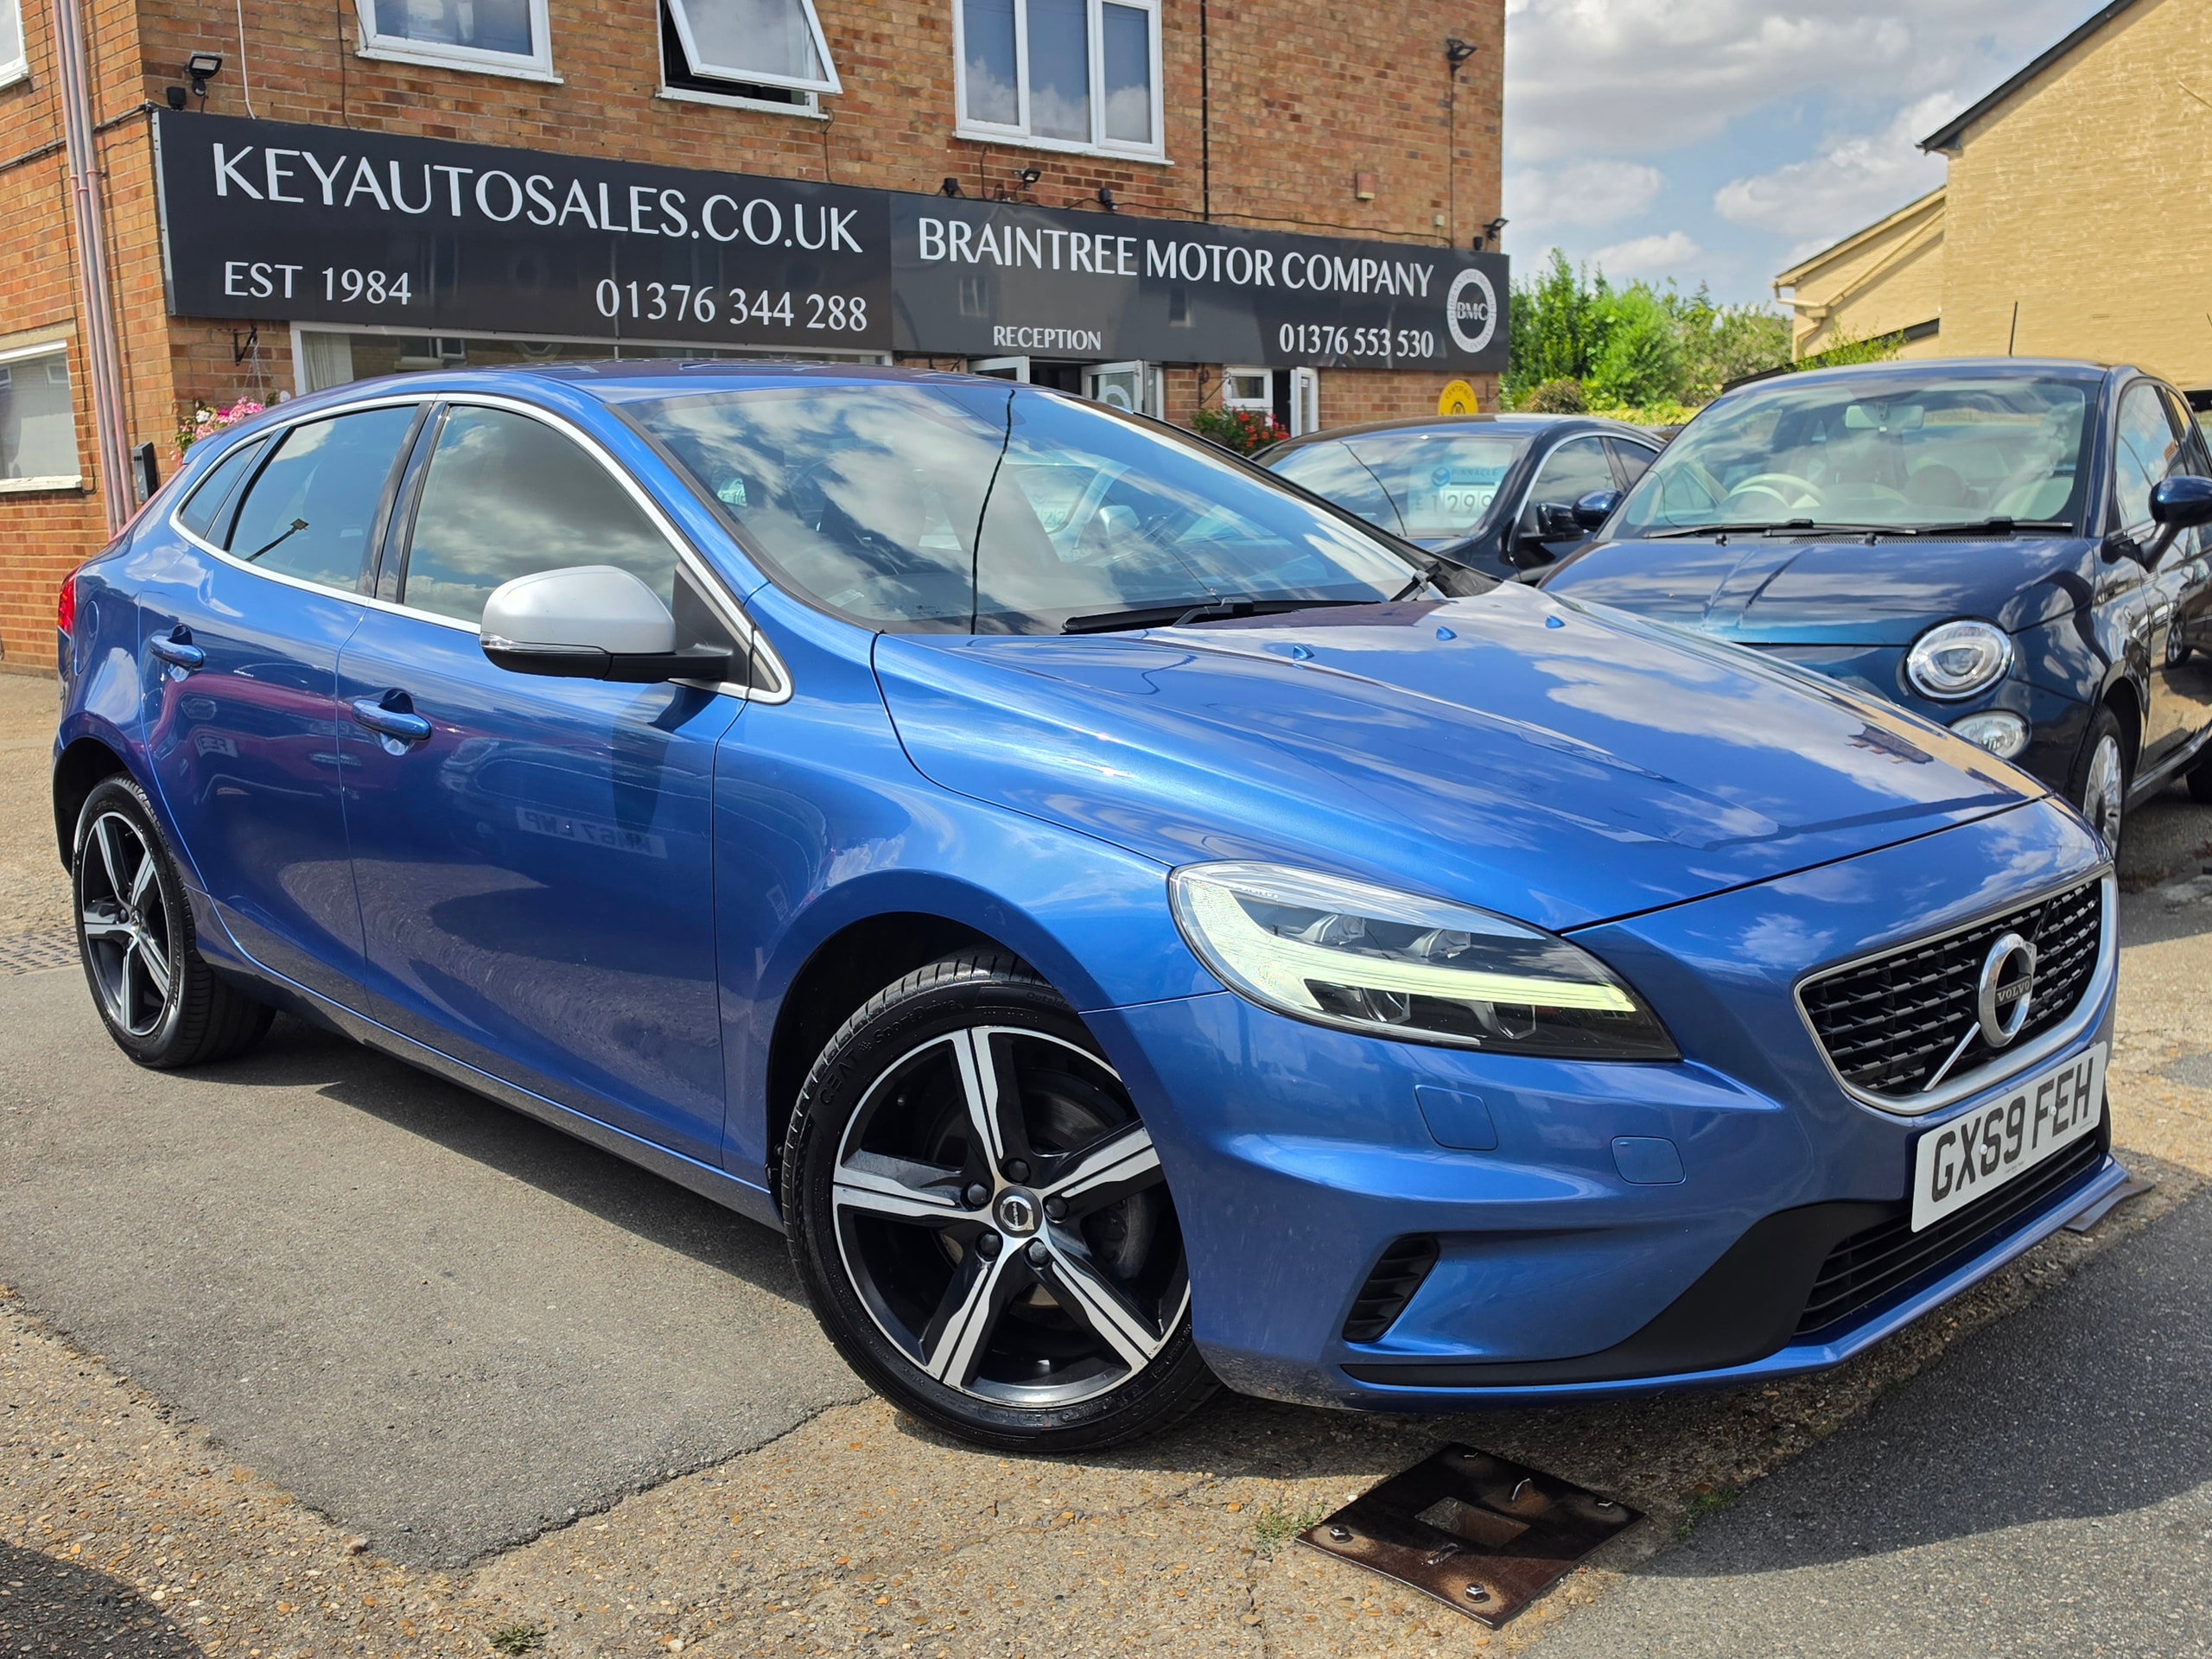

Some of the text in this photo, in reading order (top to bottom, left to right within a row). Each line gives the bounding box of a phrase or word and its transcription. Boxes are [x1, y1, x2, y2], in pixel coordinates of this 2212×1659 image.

[213, 143, 863, 253] KEYAUTOSALES.CO.UK
[918, 217, 1137, 276] BRAINTREE
[1147, 239, 1275, 286] MOTOR
[1281, 251, 1434, 297] COMPANY
[225, 261, 411, 305] EST 1984
[596, 278, 868, 332] 01376 344 288
[1456, 302, 1490, 321] BMC
[994, 326, 1101, 351] RECEPTION
[1279, 323, 1348, 355] 01376
[1353, 327, 1391, 357] 553
[1396, 329, 1434, 359] 530
[1451, 468, 1499, 477] PINNACLE
[1997, 979, 2031, 1003] VOLVO
[1930, 1056, 2094, 1204] GX69 FEH
